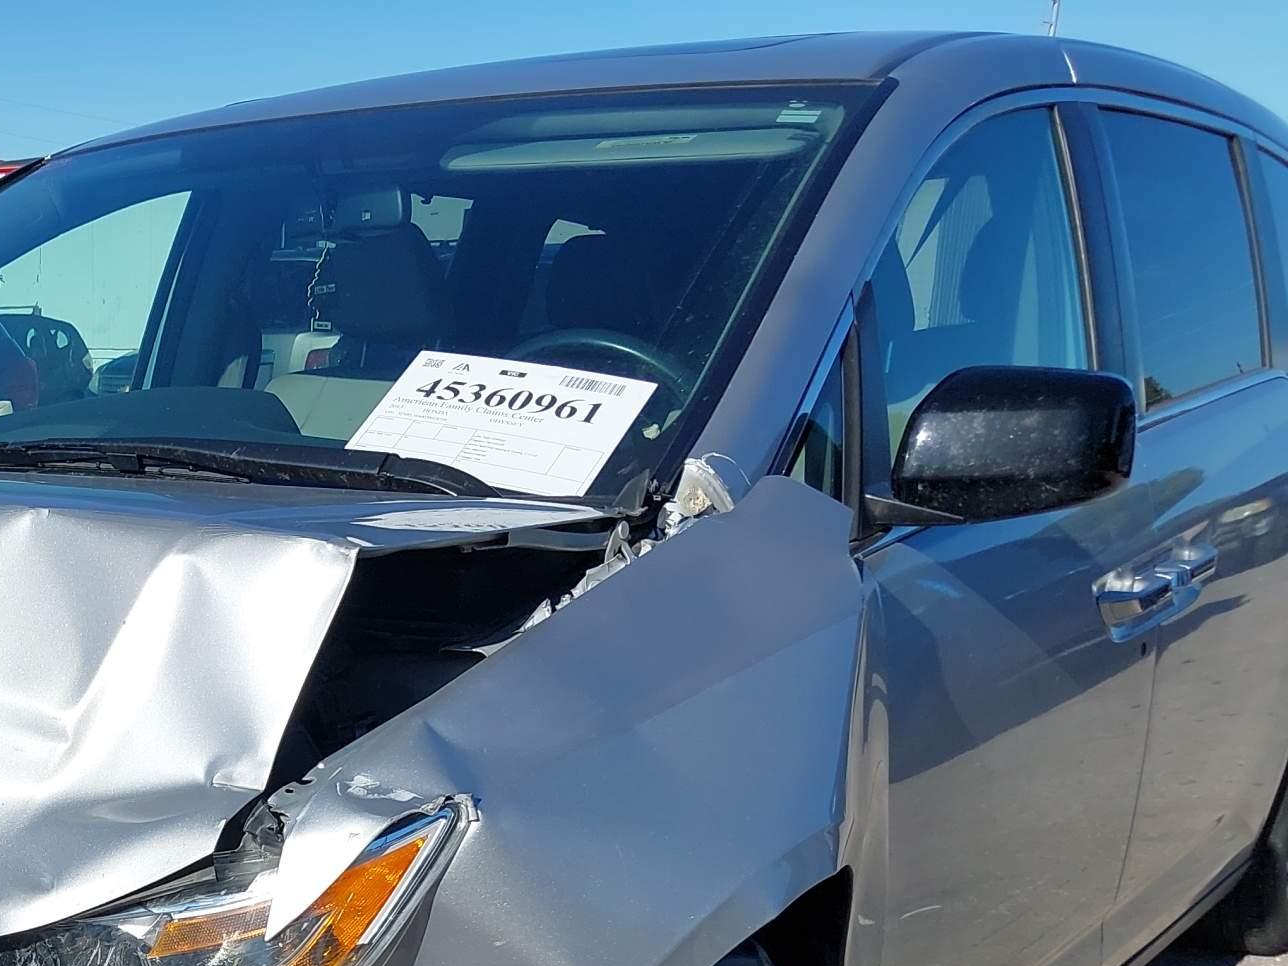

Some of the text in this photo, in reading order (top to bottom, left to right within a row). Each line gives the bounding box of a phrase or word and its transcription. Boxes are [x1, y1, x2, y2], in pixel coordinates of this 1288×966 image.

[392, 396, 545, 424] American Family Claims Center
[415, 378, 603, 425] 45360961
